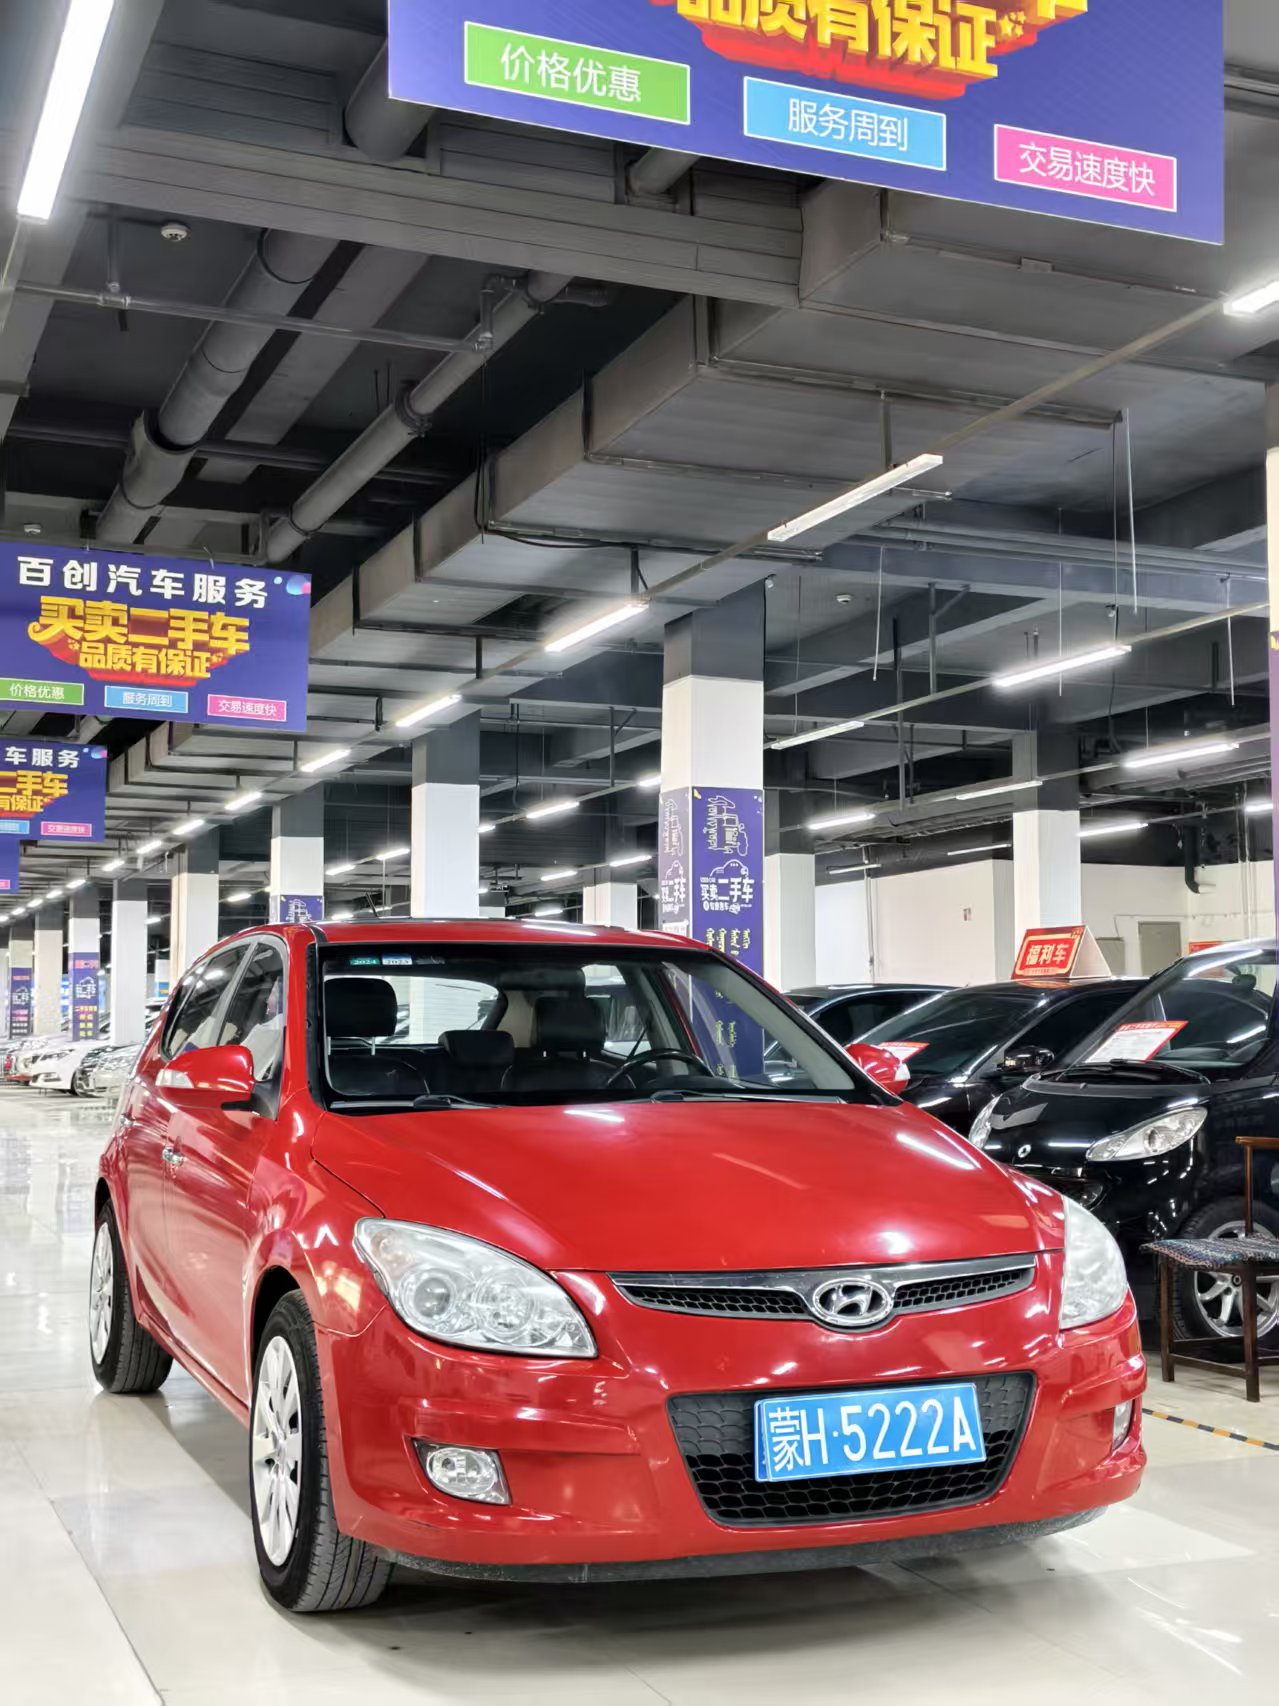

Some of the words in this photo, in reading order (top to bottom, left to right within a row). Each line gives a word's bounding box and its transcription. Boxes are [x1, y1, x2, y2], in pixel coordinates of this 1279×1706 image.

[676, 0, 998, 76] 有保证
[500, 42, 642, 102] 价格优惠
[787, 97, 909, 152] 服务周到
[1017, 140, 1156, 197] 交易速度快
[17, 555, 268, 609] 百创汽车服务
[27, 594, 250, 656] 买卖二手车
[78, 640, 211, 679] 品质有保证
[9, 683, 65, 700] 价格优惠
[217, 699, 278, 717] 交易速度快
[4, 746, 80, 769] 车服务
[1025, 943, 1070, 966] 福利车
[768, 1396, 977, 1472] 蒙H·5222A
